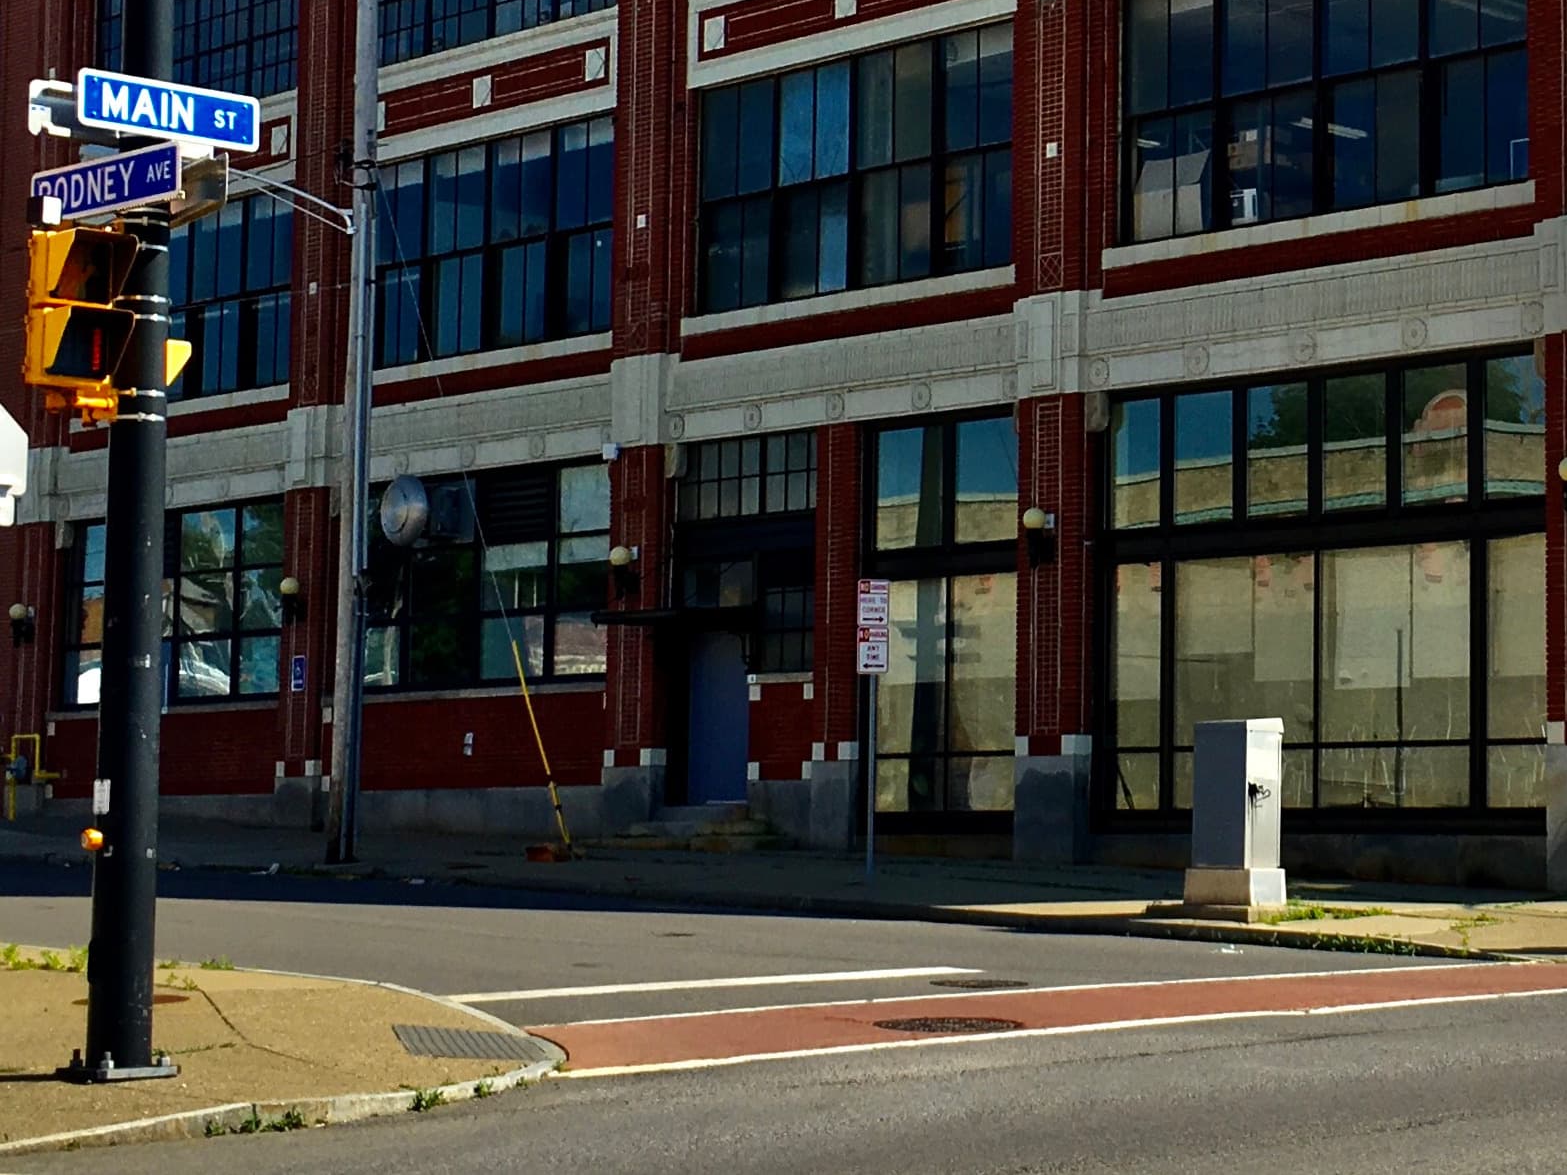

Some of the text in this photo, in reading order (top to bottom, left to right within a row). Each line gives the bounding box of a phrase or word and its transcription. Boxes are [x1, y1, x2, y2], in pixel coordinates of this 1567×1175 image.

[101, 82, 237, 132] MAIN ST
[146, 159, 171, 183] AVE
